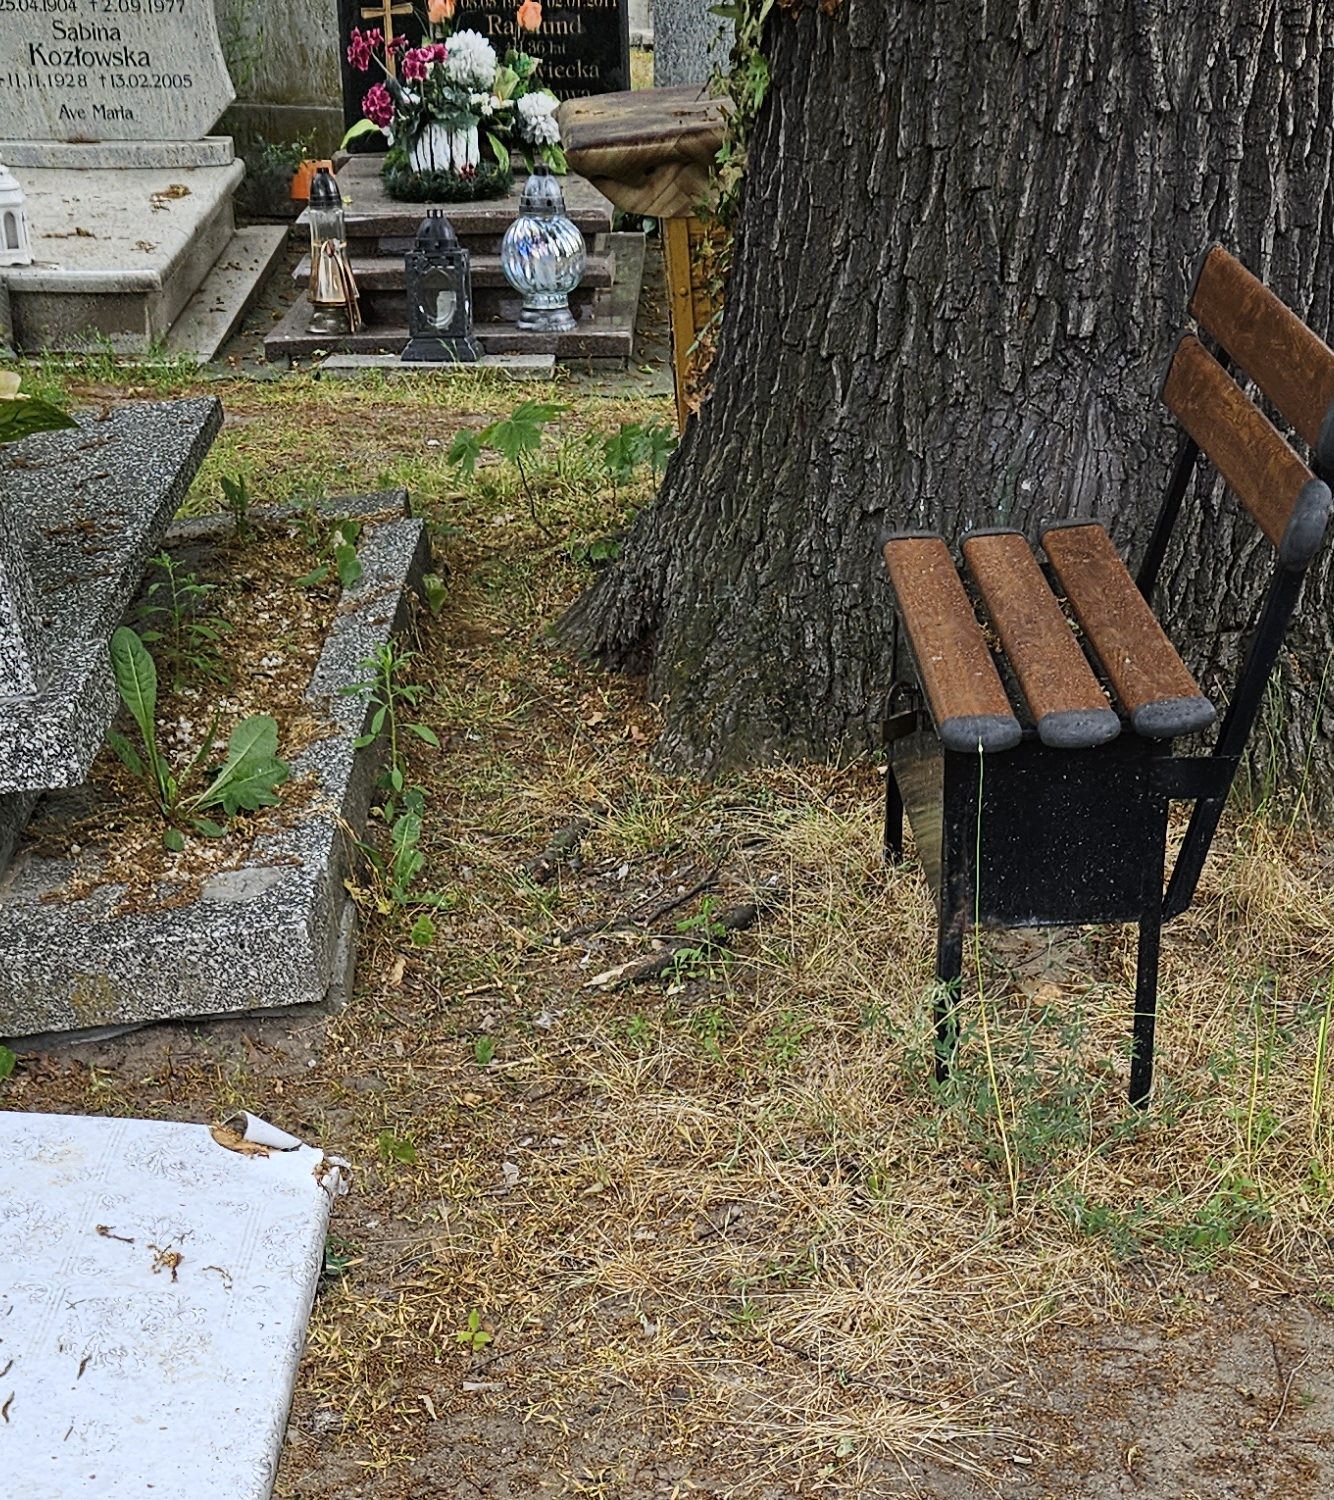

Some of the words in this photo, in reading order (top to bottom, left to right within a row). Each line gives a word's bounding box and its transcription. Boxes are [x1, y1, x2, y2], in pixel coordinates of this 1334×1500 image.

[52, 20, 121, 41] Sabina
[486, 13, 583, 39] Rajund
[29, 43, 151, 67] Kozłowska
[8, 74, 88, 88] 11.11.1928
[110, 73, 193, 88] 13.02.2005
[58, 104, 86, 120] Ave
[93, 104, 134, 121] Maria
